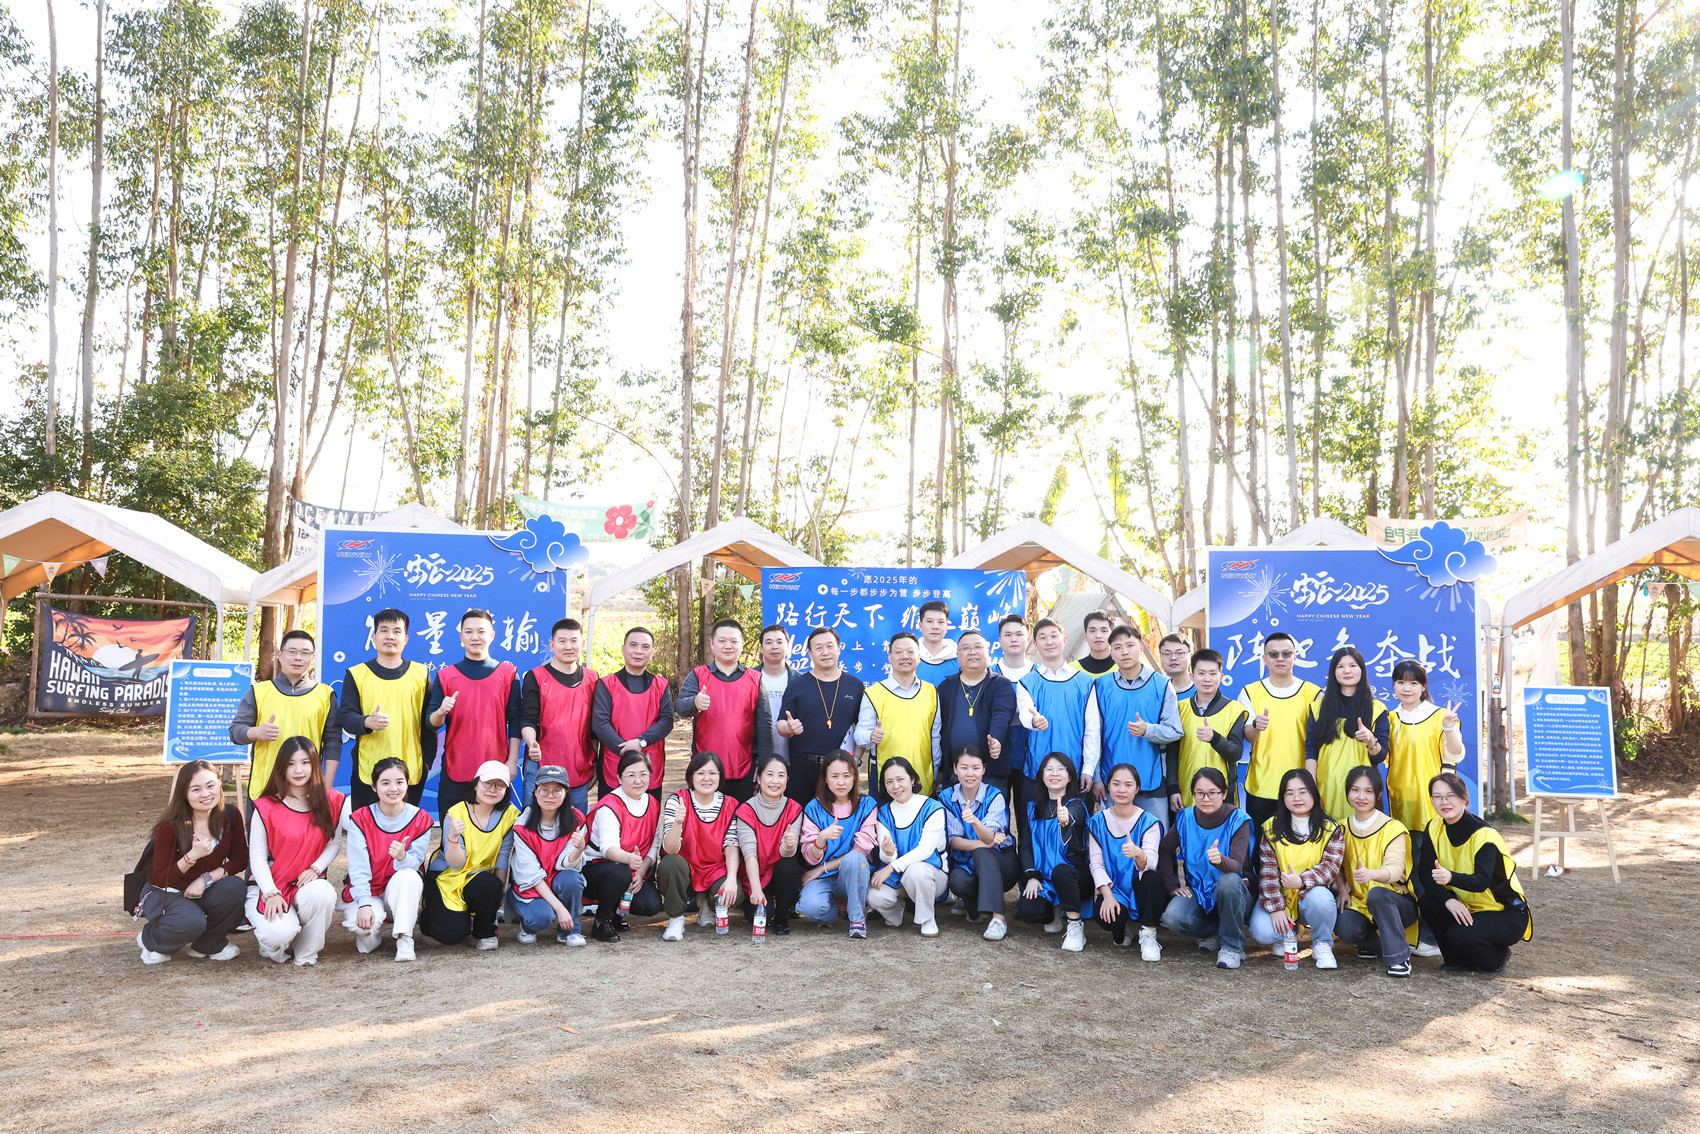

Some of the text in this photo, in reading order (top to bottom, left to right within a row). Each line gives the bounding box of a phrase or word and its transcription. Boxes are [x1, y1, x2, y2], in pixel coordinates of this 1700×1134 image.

[863, 575, 918, 585] 愿2025年的
[830, 587, 952, 599] 每一步都步步为营 步步登高
[775, 601, 885, 629] 路行天下
[49, 650, 101, 686] HAWAII
[46, 680, 110, 701] SURFING
[67, 697, 161, 708] ENDLESS SUMMER
[99, 707, 115, 715] Surf
